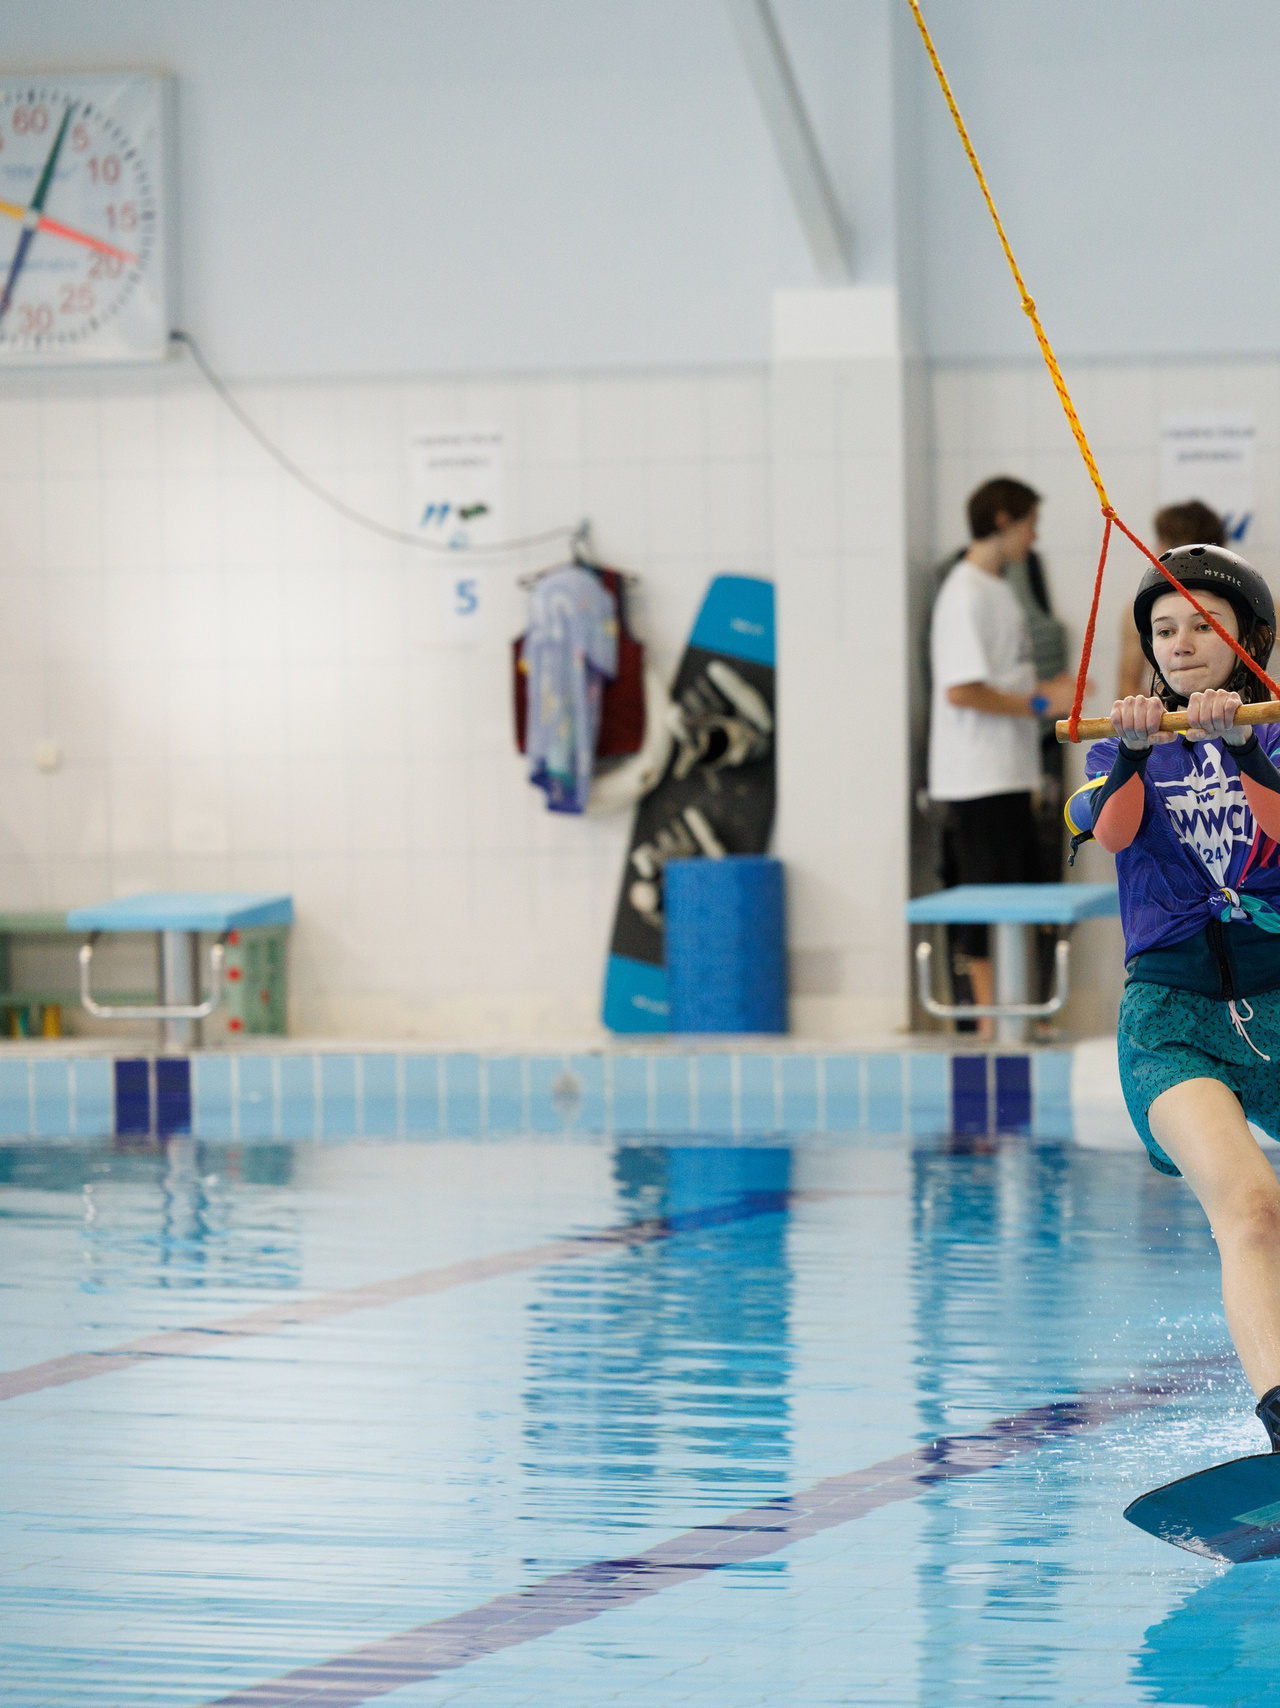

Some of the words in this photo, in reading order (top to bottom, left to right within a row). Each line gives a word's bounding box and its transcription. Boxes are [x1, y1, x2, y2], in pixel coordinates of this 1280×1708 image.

[12, 105, 48, 136] 60
[72, 124, 90, 153] 5
[87, 153, 121, 185] 10
[105, 202, 138, 231] 15
[88, 246, 123, 279] 20
[60, 284, 95, 313] 25
[19, 304, 53, 335] 30
[1204, 569, 1241, 587] MYSTIC
[454, 579, 479, 616] 5
